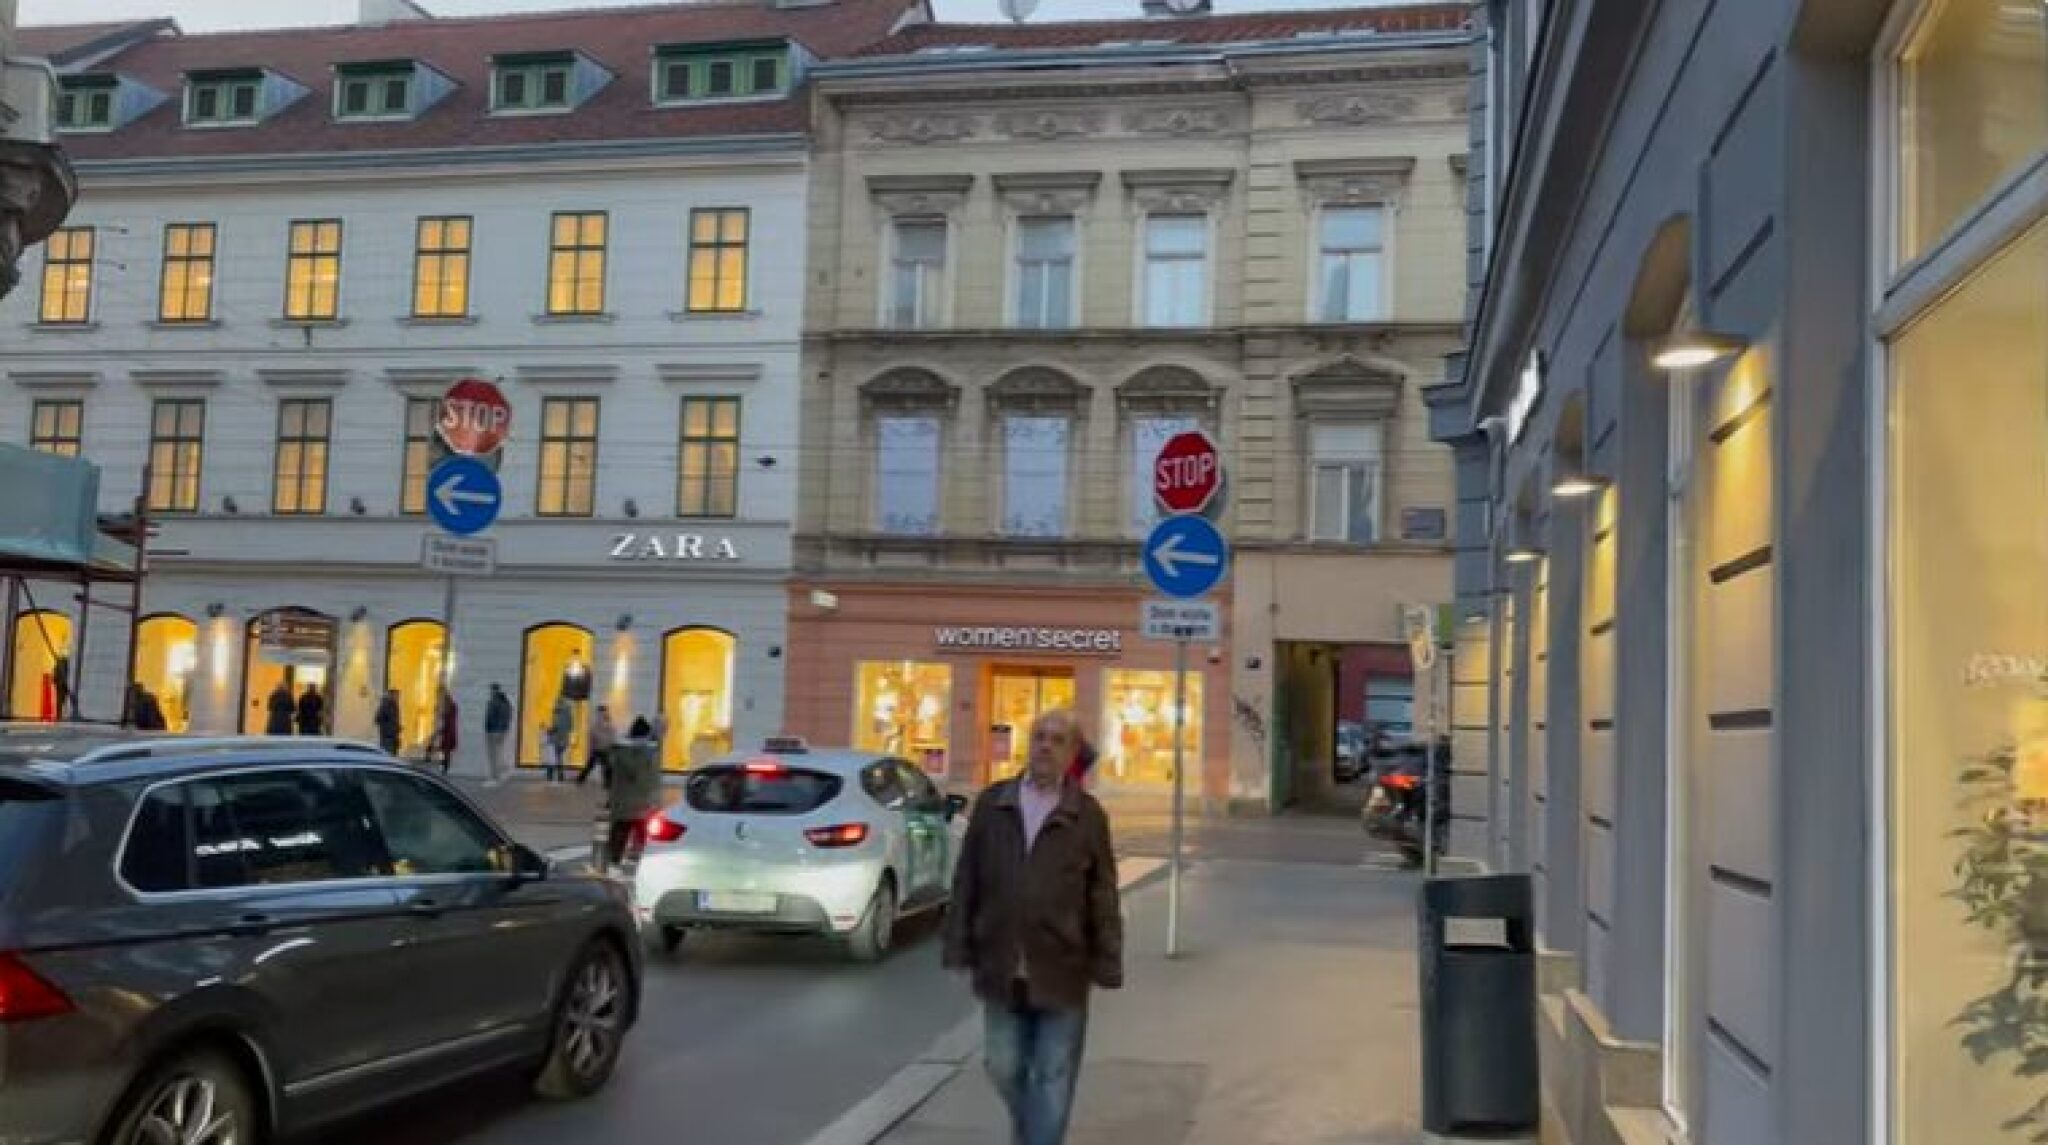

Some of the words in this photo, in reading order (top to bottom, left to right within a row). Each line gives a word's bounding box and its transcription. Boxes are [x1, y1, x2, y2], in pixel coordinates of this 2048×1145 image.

[444, 399, 507, 431] STOP
[1157, 452, 1214, 490] STOP
[610, 533, 739, 559] ZARA
